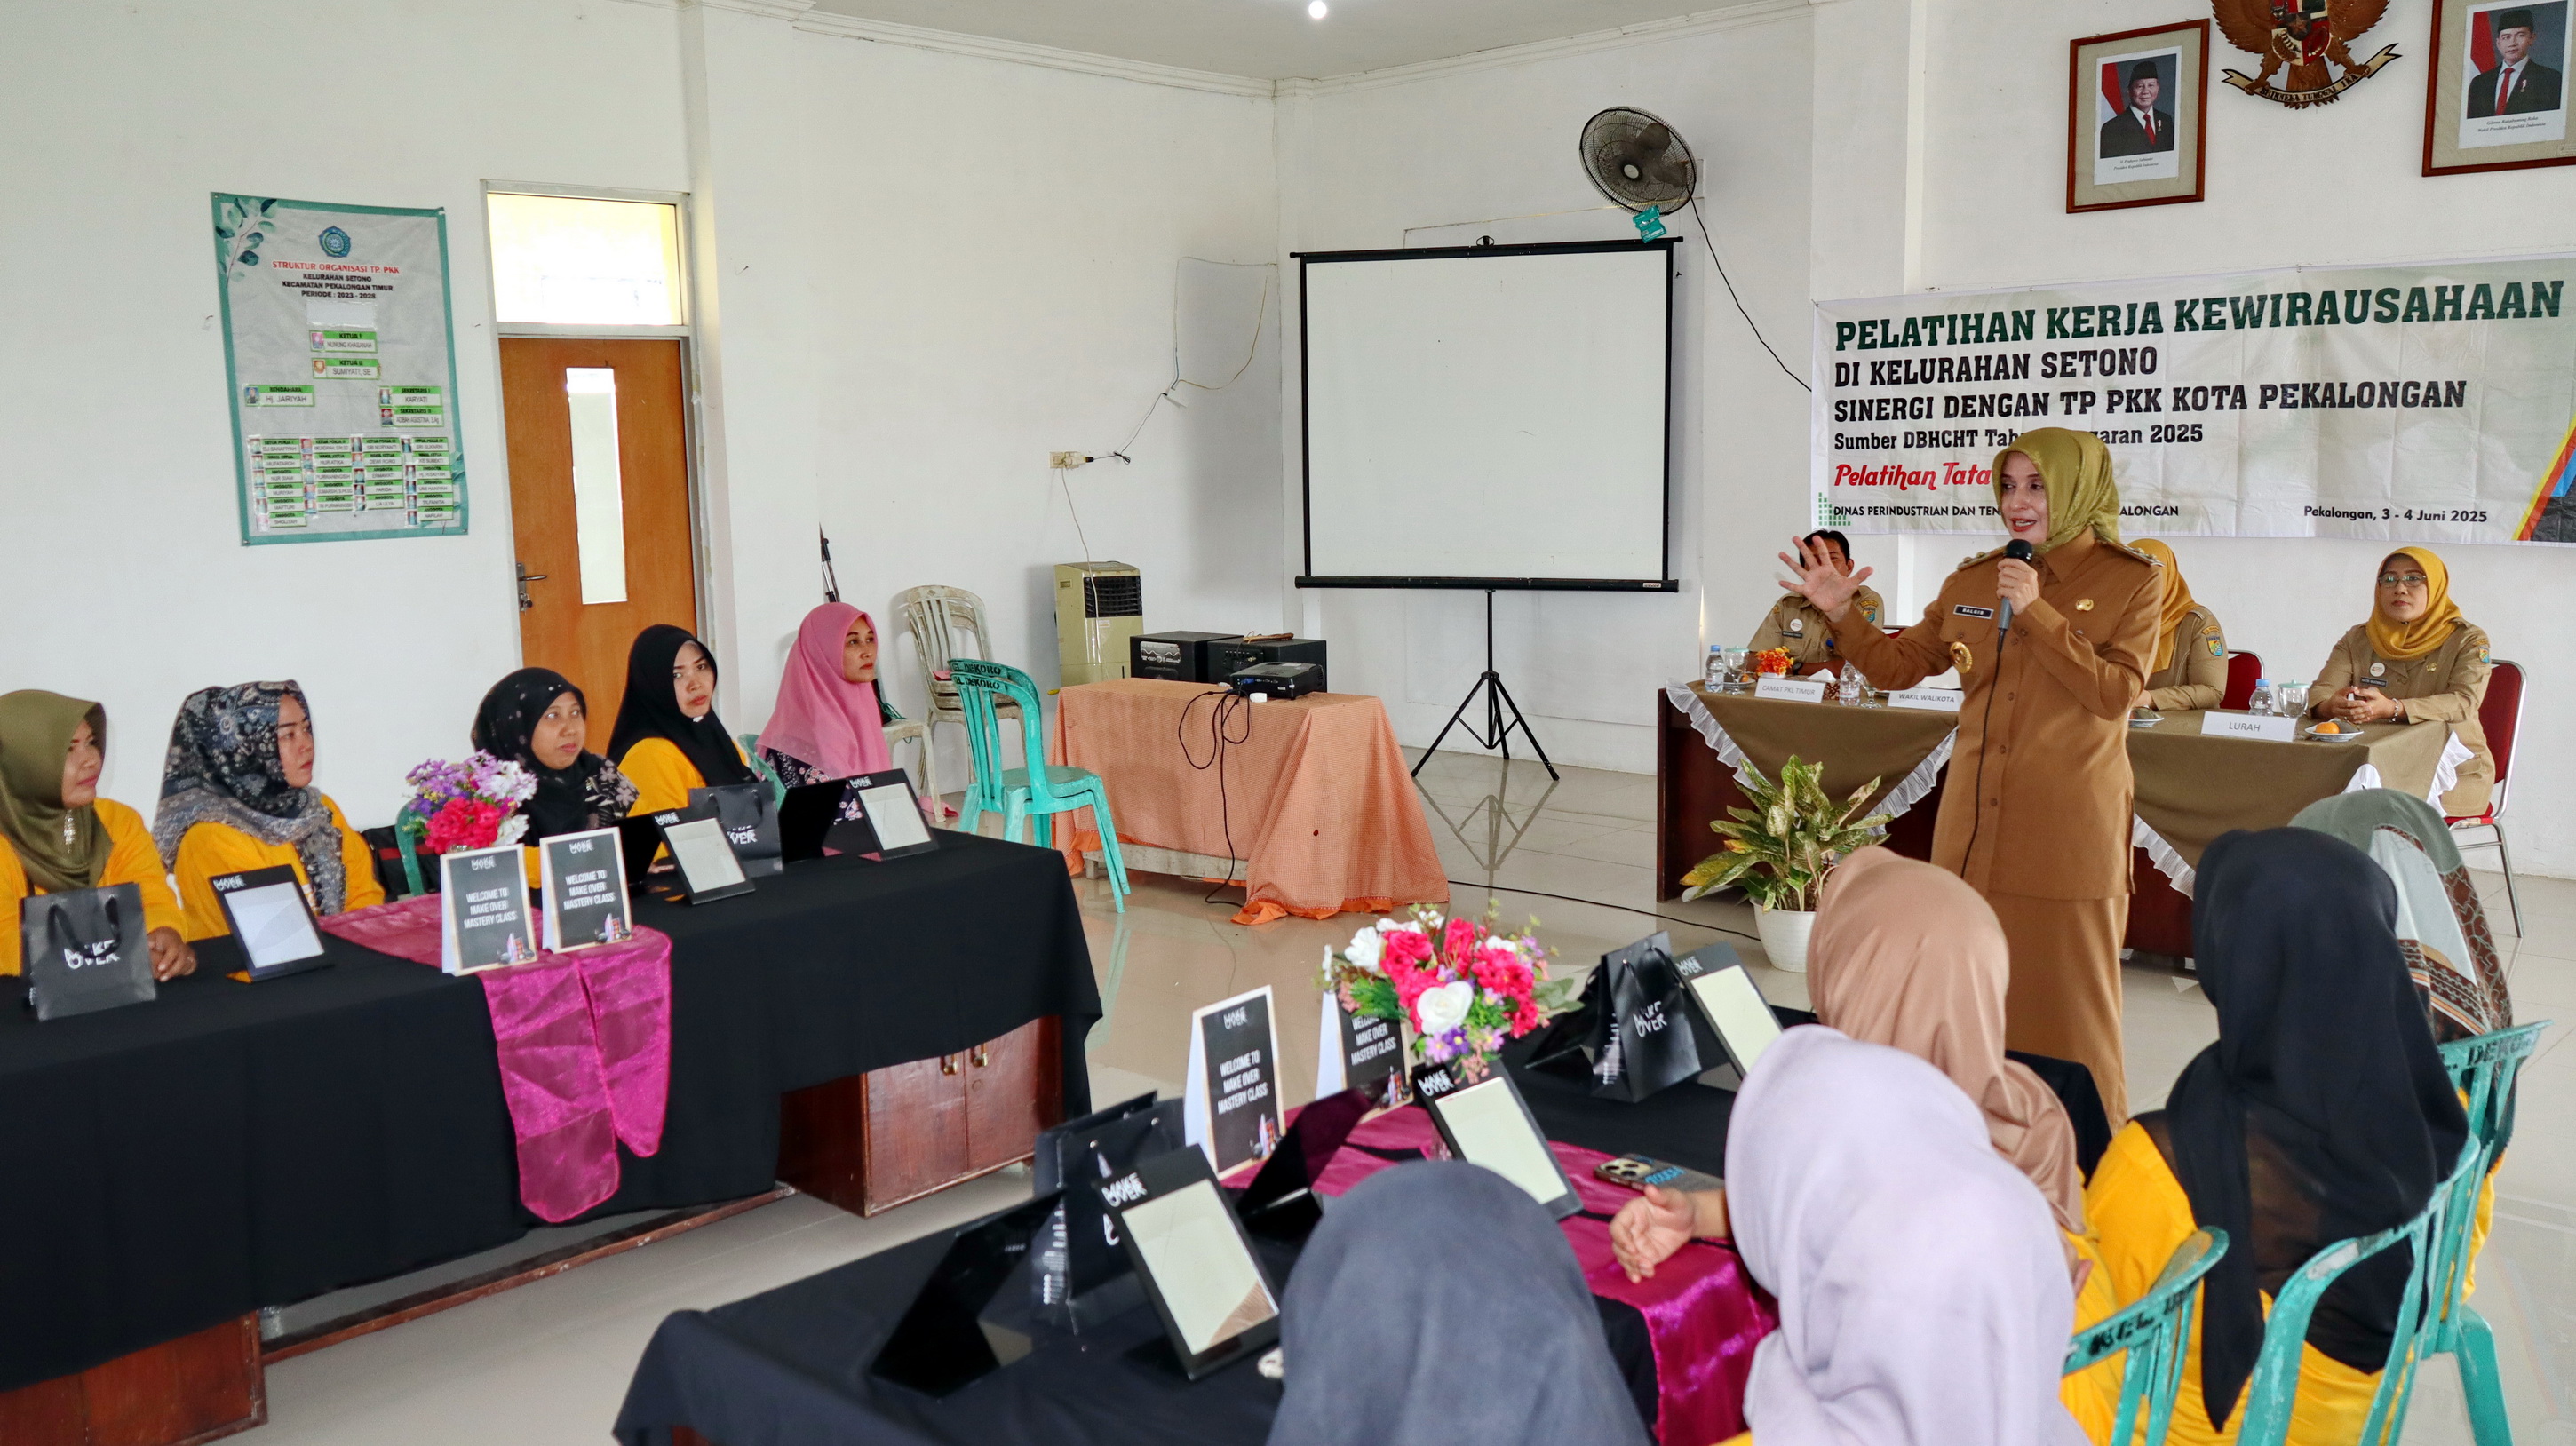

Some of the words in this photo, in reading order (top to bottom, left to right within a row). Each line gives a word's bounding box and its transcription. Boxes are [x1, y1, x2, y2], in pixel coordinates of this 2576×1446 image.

[2341, 74, 2358, 87] IKA
[273, 261, 316, 270] STRUKTUR
[319, 264, 368, 273] ORGANISASI
[1835, 309, 2035, 351] PELATIHAN
[2047, 300, 2164, 340] KERJA
[2174, 280, 2564, 332] KEWIRAUSAHAAN
[1835, 361, 1860, 388] DI
[1870, 353, 2031, 386] KELURAHAN
[2040, 346, 2158, 379] SETONO
[1834, 396, 1934, 423] SINERGI
[1944, 392, 2050, 420] DENGAN
[2059, 391, 2097, 416] TP
[2106, 388, 2162, 414] PKK
[2172, 385, 2247, 412] KOTA
[2259, 380, 2467, 409] PEKALONGAN
[1834, 432, 1897, 450] Sumber
[1904, 429, 1978, 449] DBHCHT
[2151, 424, 2203, 443] 2025
[1834, 463, 1937, 491] Pelatihan
[1943, 461, 1992, 486] Tata
[1833, 506, 1864, 516] DINAS
[1867, 506, 1949, 516] PERINDUSTRIAN
[1953, 506, 1976, 516] DAN
[2304, 506, 2377, 521] Pekalongan,
[2381, 509, 2390, 520] 3
[2405, 509, 2413, 520] 4
[2417, 510, 2446, 522] Juni
[2450, 510, 2487, 523] 2025
[1761, 685, 1784, 694] CAMAT
[1795, 687, 1816, 695] TIMUR
[1898, 693, 1920, 702] WAKIL
[1922, 694, 1955, 703] WALIKOTA
[2229, 722, 2261, 732] LURAH
[565, 872, 596, 886] WELCOME
[596, 870, 607, 880] TO
[466, 889, 498, 904] WELCOME
[498, 888, 508, 899] TO
[568, 886, 588, 898] MAKE
[588, 882, 606, 894] OVER
[470, 903, 489, 916] MAKE
[489, 900, 508, 912] OVER
[563, 896, 594, 910] MASTERY
[594, 892, 616, 905] CLASS
[464, 915, 495, 929] MASTERY
[496, 911, 518, 924] CLASS
[1356, 1029, 1373, 1047] MAKE
[1372, 1022, 1388, 1040] OVER
[1351, 1043, 1379, 1067] MASTERY
[1378, 1036, 1397, 1055] CLASS
[1220, 1053, 1252, 1078] WELCOME
[1251, 1049, 1261, 1065] TO
[1223, 1074, 1243, 1095] MAKE
[1242, 1068, 1260, 1087] OVER
[1218, 1089, 1248, 1116] MASTERY
[1247, 1082, 1269, 1102] CLASS
